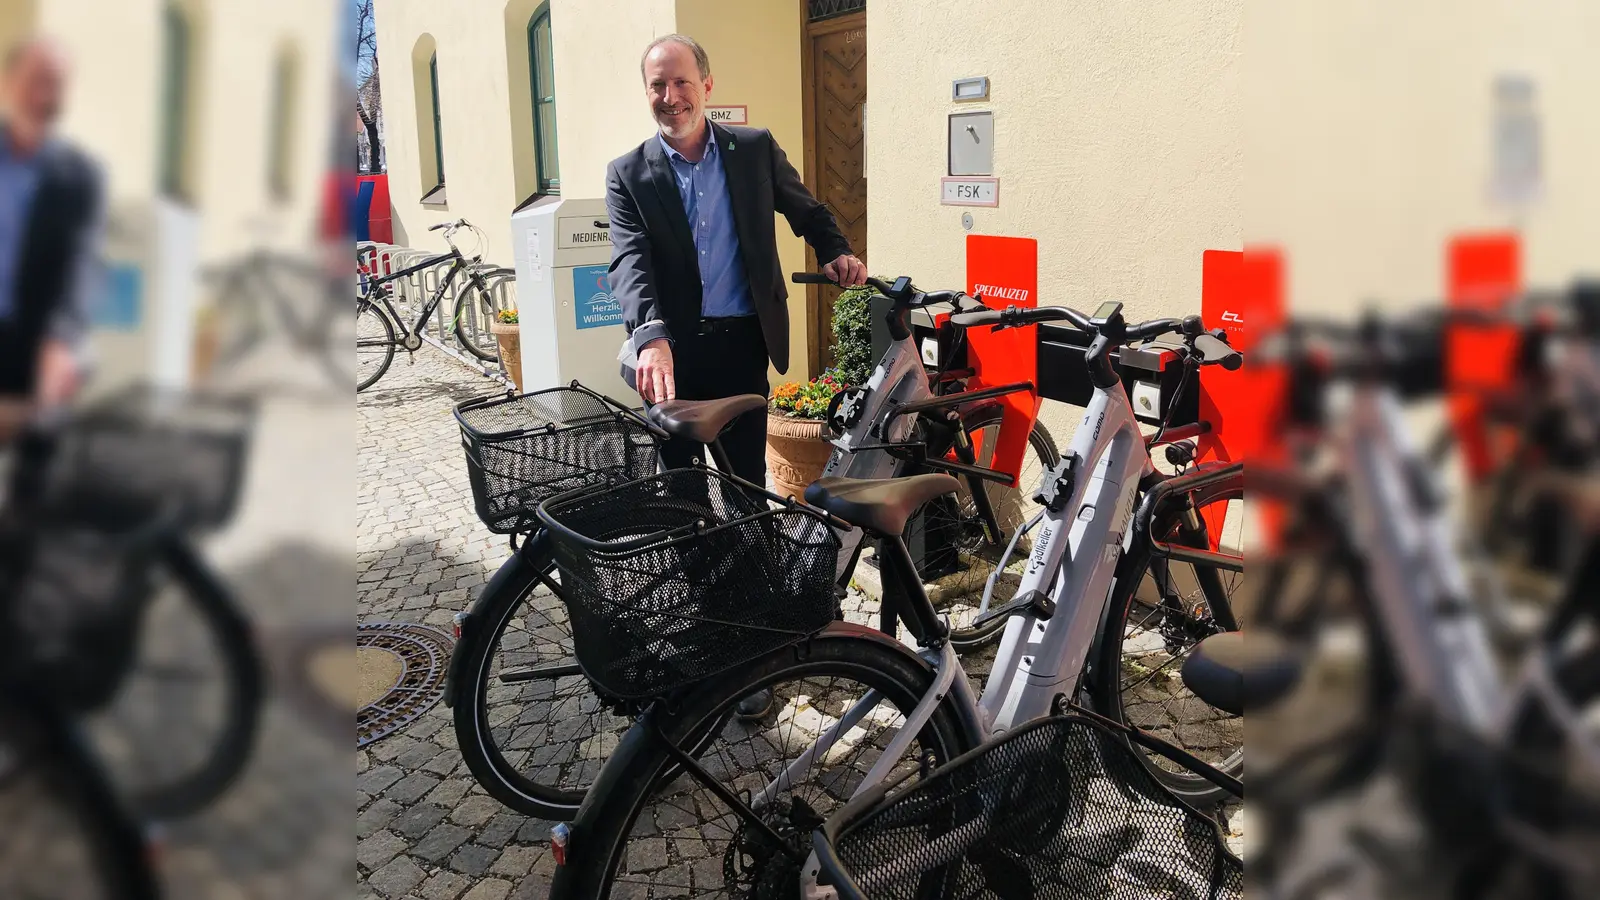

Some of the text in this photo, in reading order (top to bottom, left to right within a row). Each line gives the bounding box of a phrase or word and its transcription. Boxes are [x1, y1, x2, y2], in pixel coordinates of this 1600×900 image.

[711, 110, 732, 120] BMZ
[957, 184, 981, 199] FSK
[572, 231, 611, 243] MEDIENR
[426, 276, 448, 312] GIANT
[973, 283, 1029, 302] SPECIALIZED
[1084, 415, 1091, 426] 1
